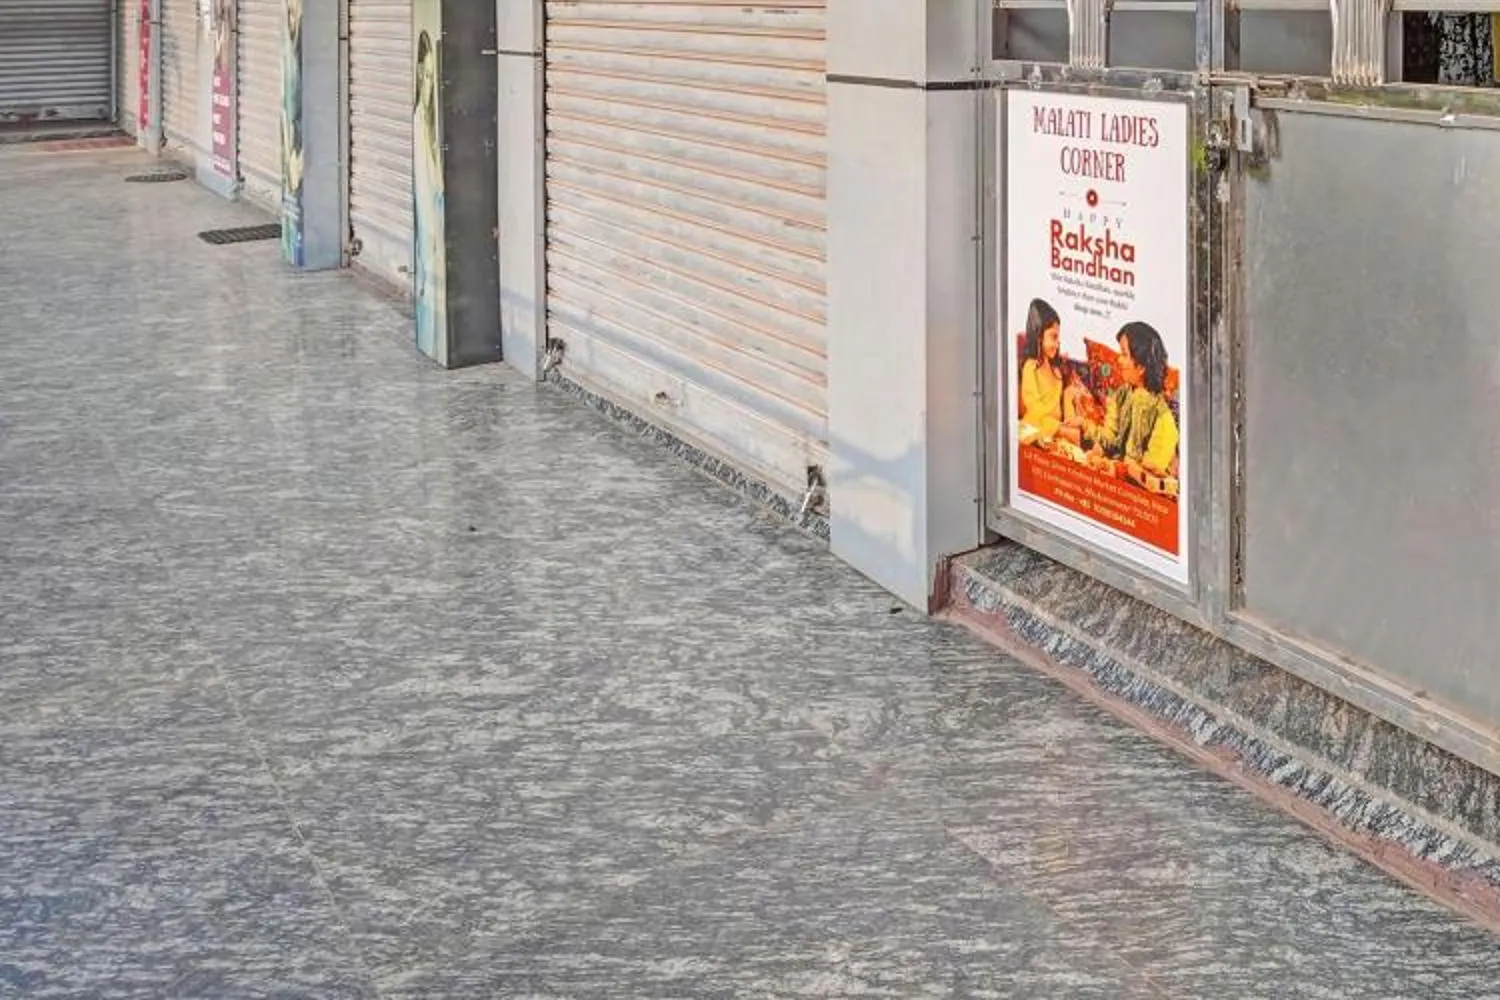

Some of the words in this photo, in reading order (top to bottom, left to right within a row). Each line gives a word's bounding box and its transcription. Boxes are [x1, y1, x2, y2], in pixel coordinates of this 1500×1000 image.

[1032, 106, 1092, 139] MALATI
[1100, 112, 1160, 148] LADIES
[1060, 145, 1126, 182] CORNER
[1050, 218, 1135, 263] Raksha
[1050, 247, 1135, 287] Bandhan
